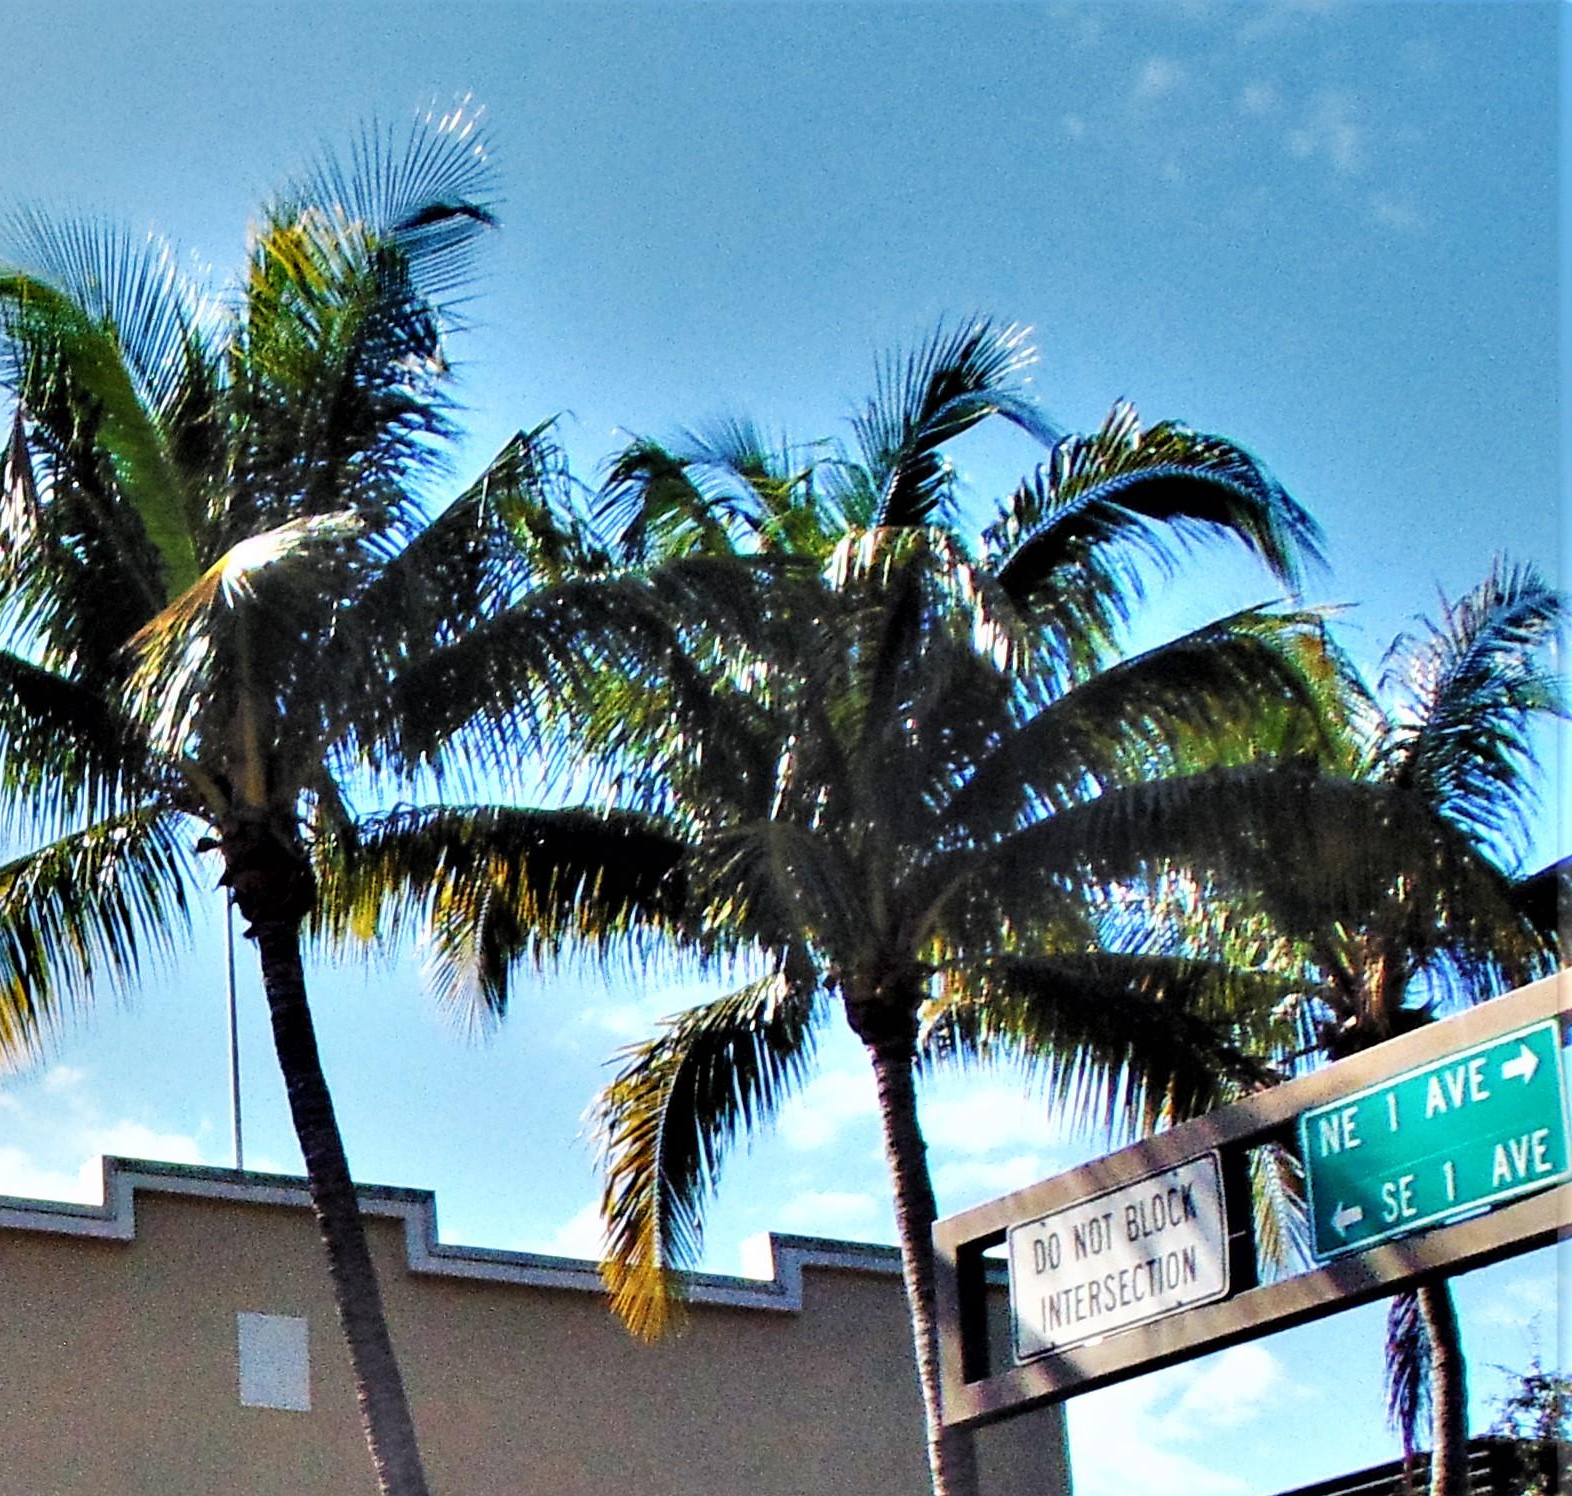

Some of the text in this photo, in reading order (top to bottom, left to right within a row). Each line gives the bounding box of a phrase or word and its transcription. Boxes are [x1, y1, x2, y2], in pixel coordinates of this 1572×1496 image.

[1319, 1057, 1491, 1157] NE 1 AVE
[1381, 1128, 1554, 1223] SE 1 AVE
[1033, 1181, 1197, 1275] DO NOT BLOCK
[1040, 1245, 1198, 1334] INTERSECTION
